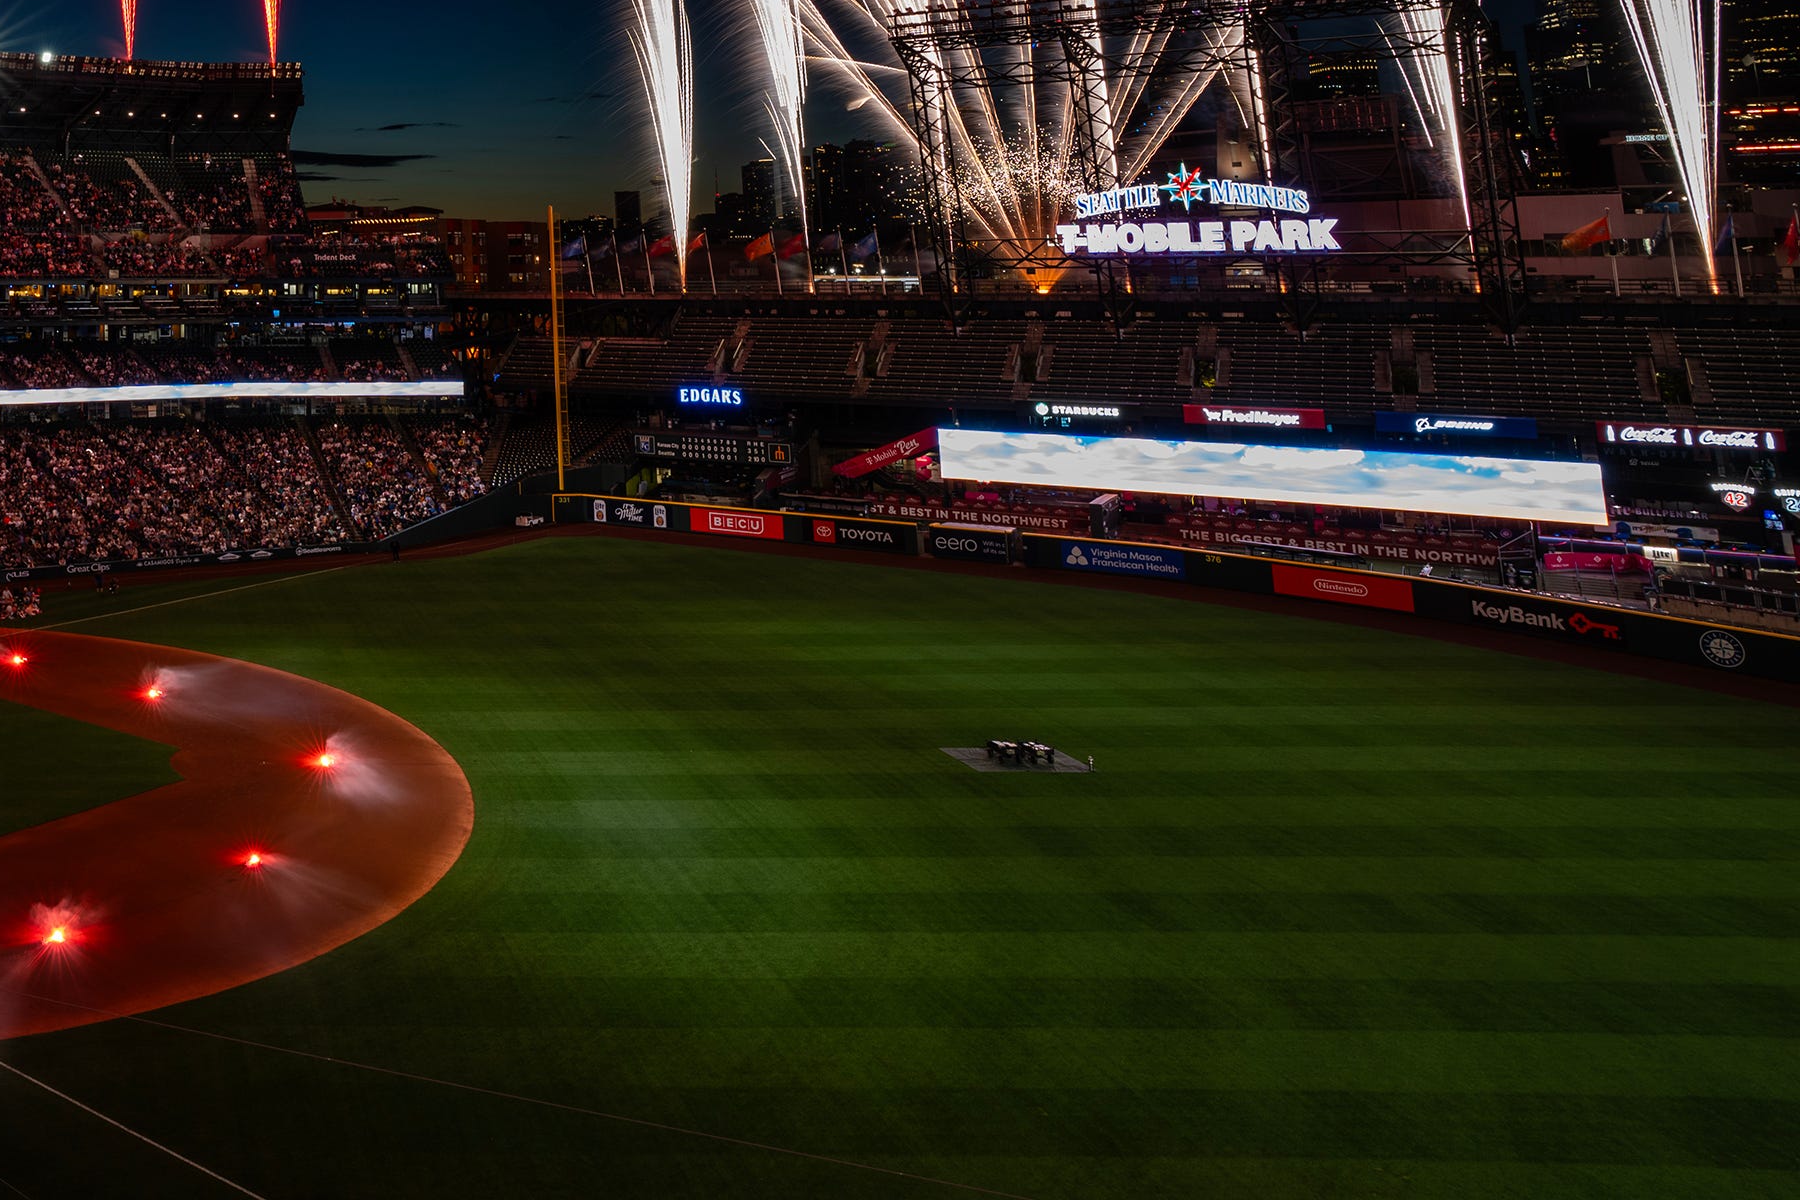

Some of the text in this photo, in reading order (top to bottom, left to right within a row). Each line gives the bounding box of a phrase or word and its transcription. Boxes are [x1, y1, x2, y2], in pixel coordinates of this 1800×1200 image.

[1075, 178, 1310, 219] SEATTLE MARINERS
[1057, 218, 1342, 254] T-MOBILE PARK
[1052, 405, 1119, 416] STARBUCKS
[1222, 410, 1254, 423] Fred
[1724, 493, 1747, 506] 42
[900, 506, 932, 518] BEST
[936, 509, 949, 519] IN
[952, 511, 978, 522] THE
[982, 513, 1068, 528] NORTHWEST
[1686, 510, 1709, 520] BAR
[713, 516, 760, 530] BECU
[840, 528, 893, 543] TOYOTA
[935, 536, 978, 552] eero
[1180, 529, 1499, 567] THE BIGGEST & BEST IN THE NORTHW
[1091, 548, 1162, 562] Virginia Mason
[1205, 555, 1222, 564] 376
[67, 563, 111, 573] Great Clips
[1093, 558, 1179, 574] Franciscan Health
[1317, 581, 1364, 594] Nintendo
[1472, 600, 1566, 631] KeyBank
